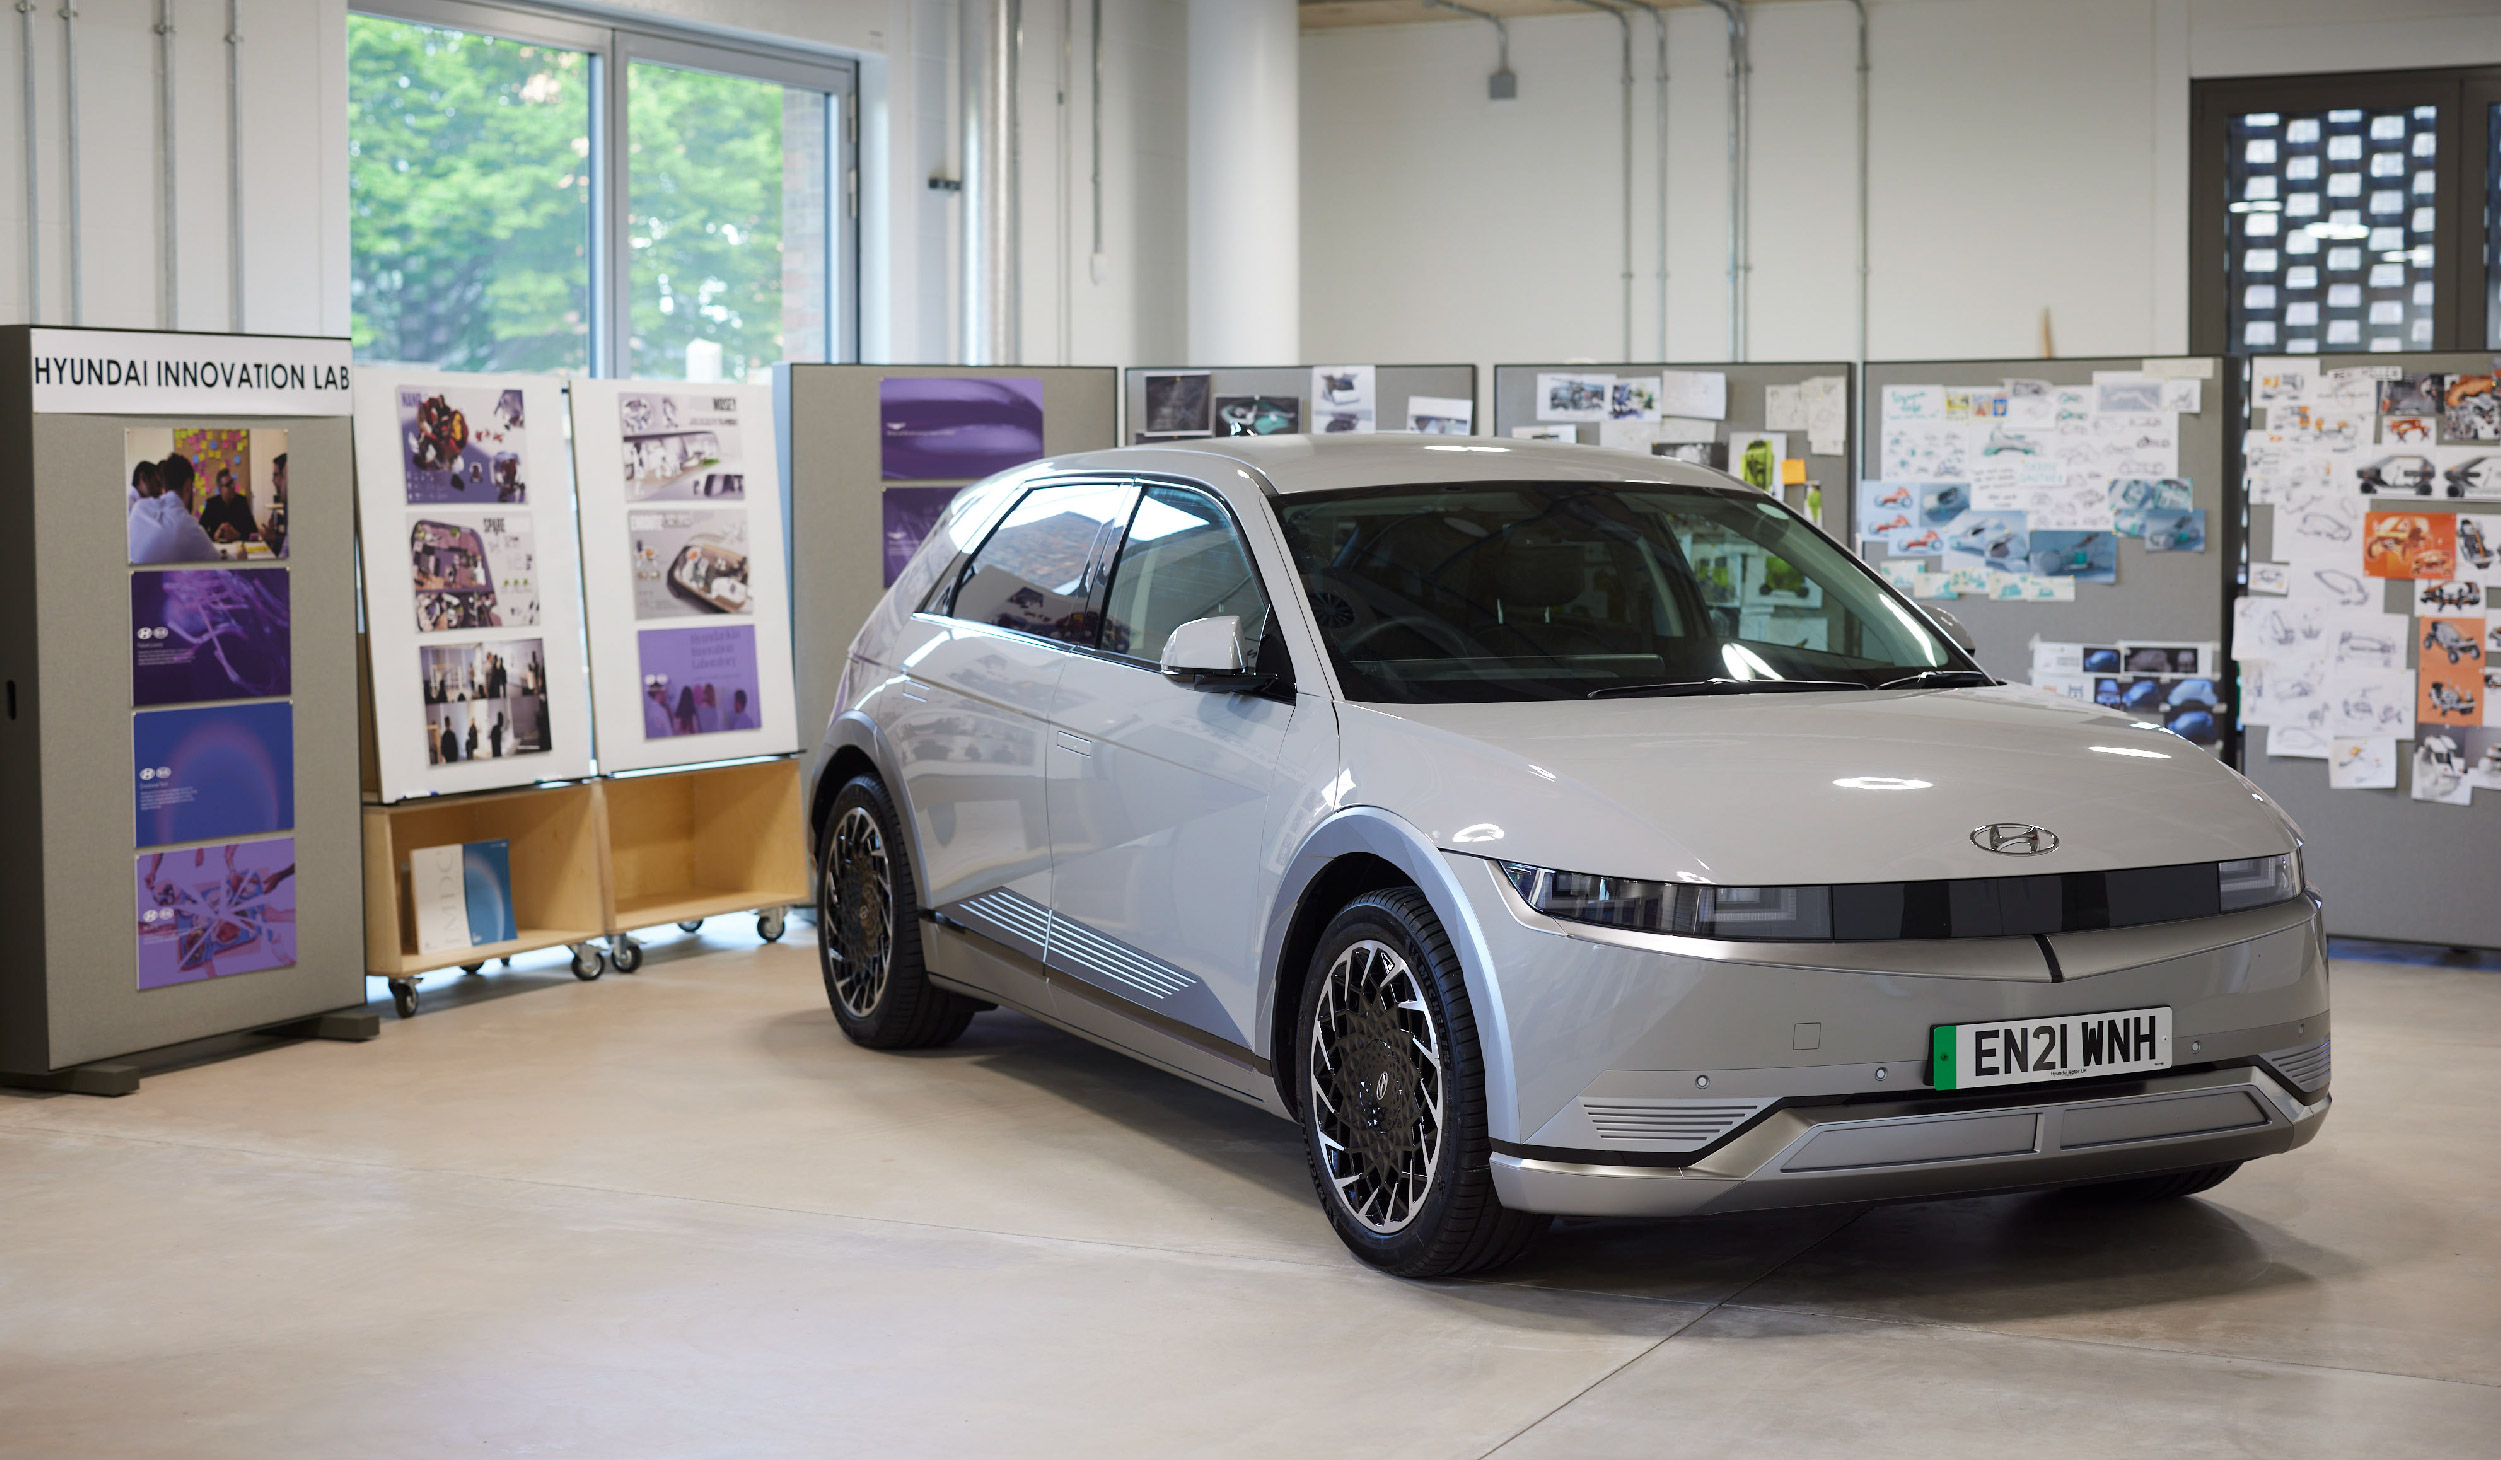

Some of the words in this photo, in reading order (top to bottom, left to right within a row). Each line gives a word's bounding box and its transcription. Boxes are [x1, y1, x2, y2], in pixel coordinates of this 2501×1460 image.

[34, 356, 148, 387] HYUNDAI
[157, 360, 306, 390] INNOVATION
[314, 365, 350, 391] LAB
[1975, 1023, 2068, 1077] EN21
[2081, 1015, 2156, 1067] WNH
